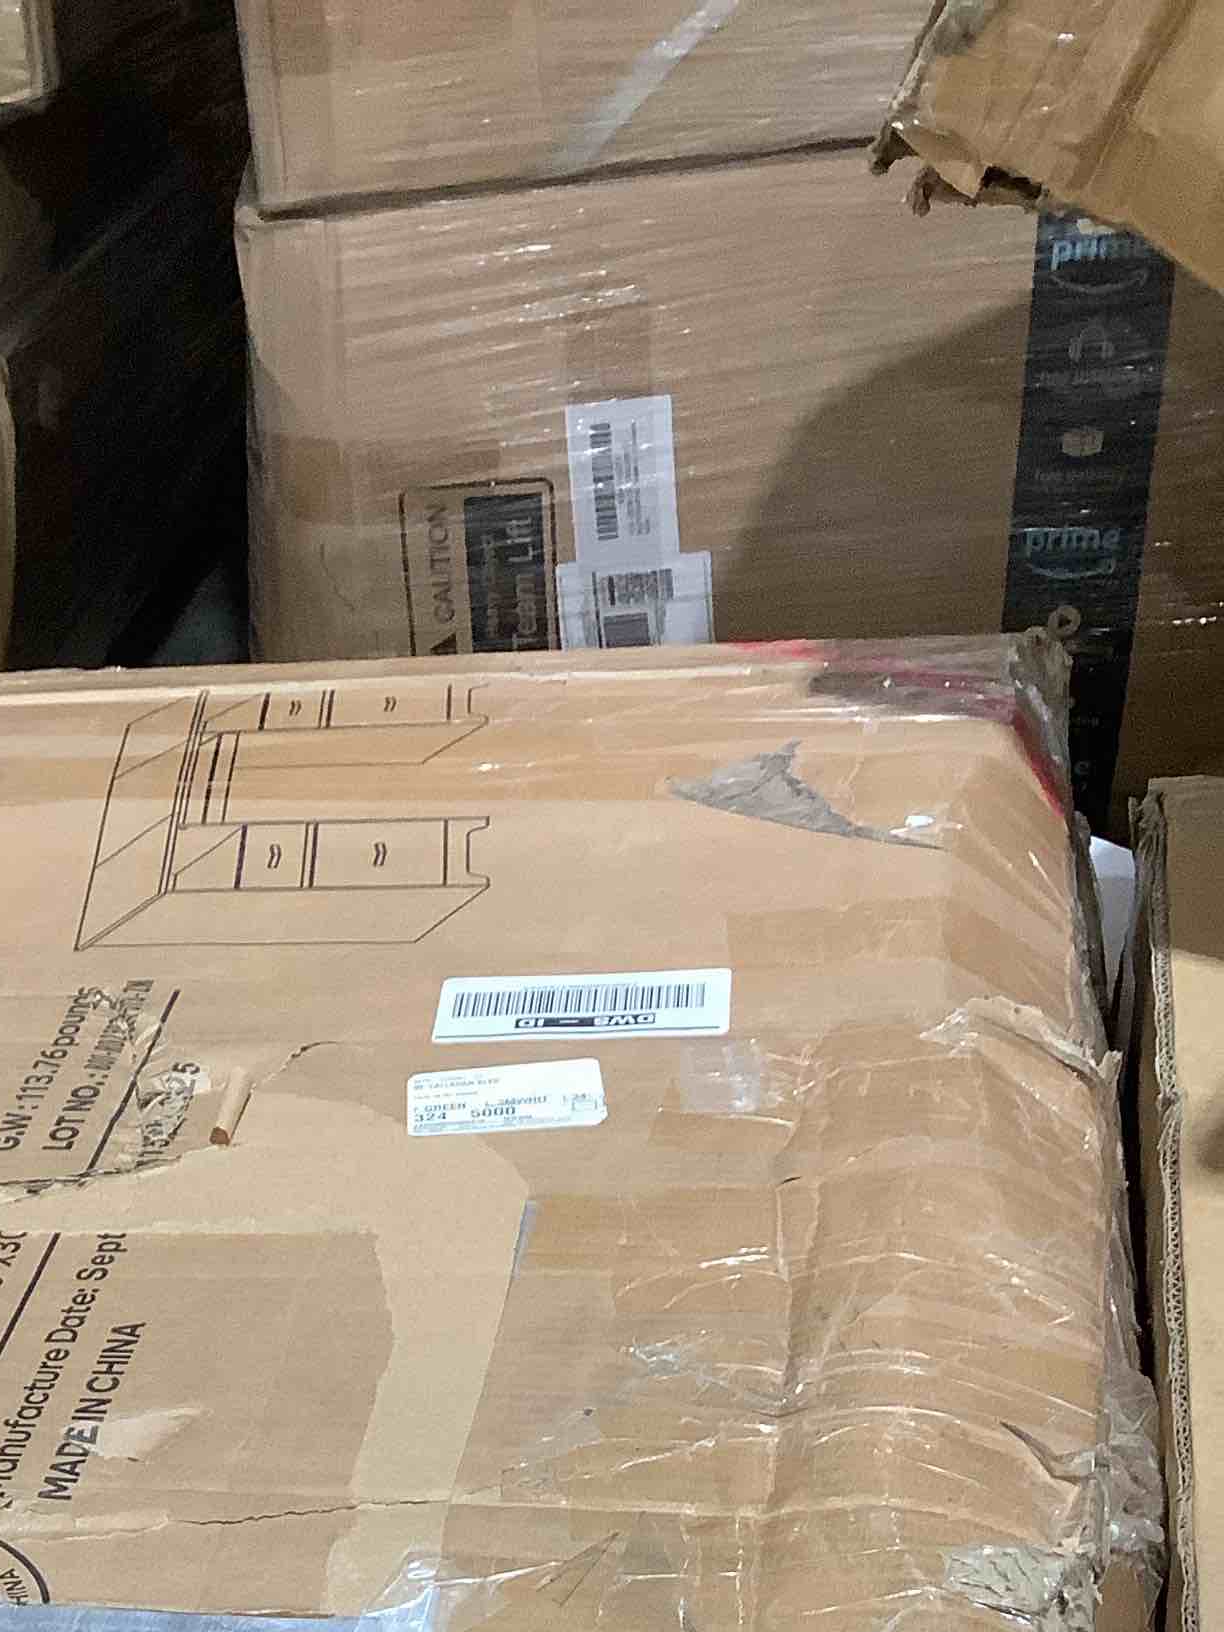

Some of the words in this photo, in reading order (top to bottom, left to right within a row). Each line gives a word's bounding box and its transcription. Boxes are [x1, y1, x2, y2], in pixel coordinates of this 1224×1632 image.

[426, 504, 455, 624] CAUTION
[42, 1114, 85, 1151] LOT
[45, 1288, 100, 1344] Date:
[86, 1322, 147, 1394] CHINA
[72, 1398, 113, 1422] IN
[38, 1426, 99, 1501] MADE
